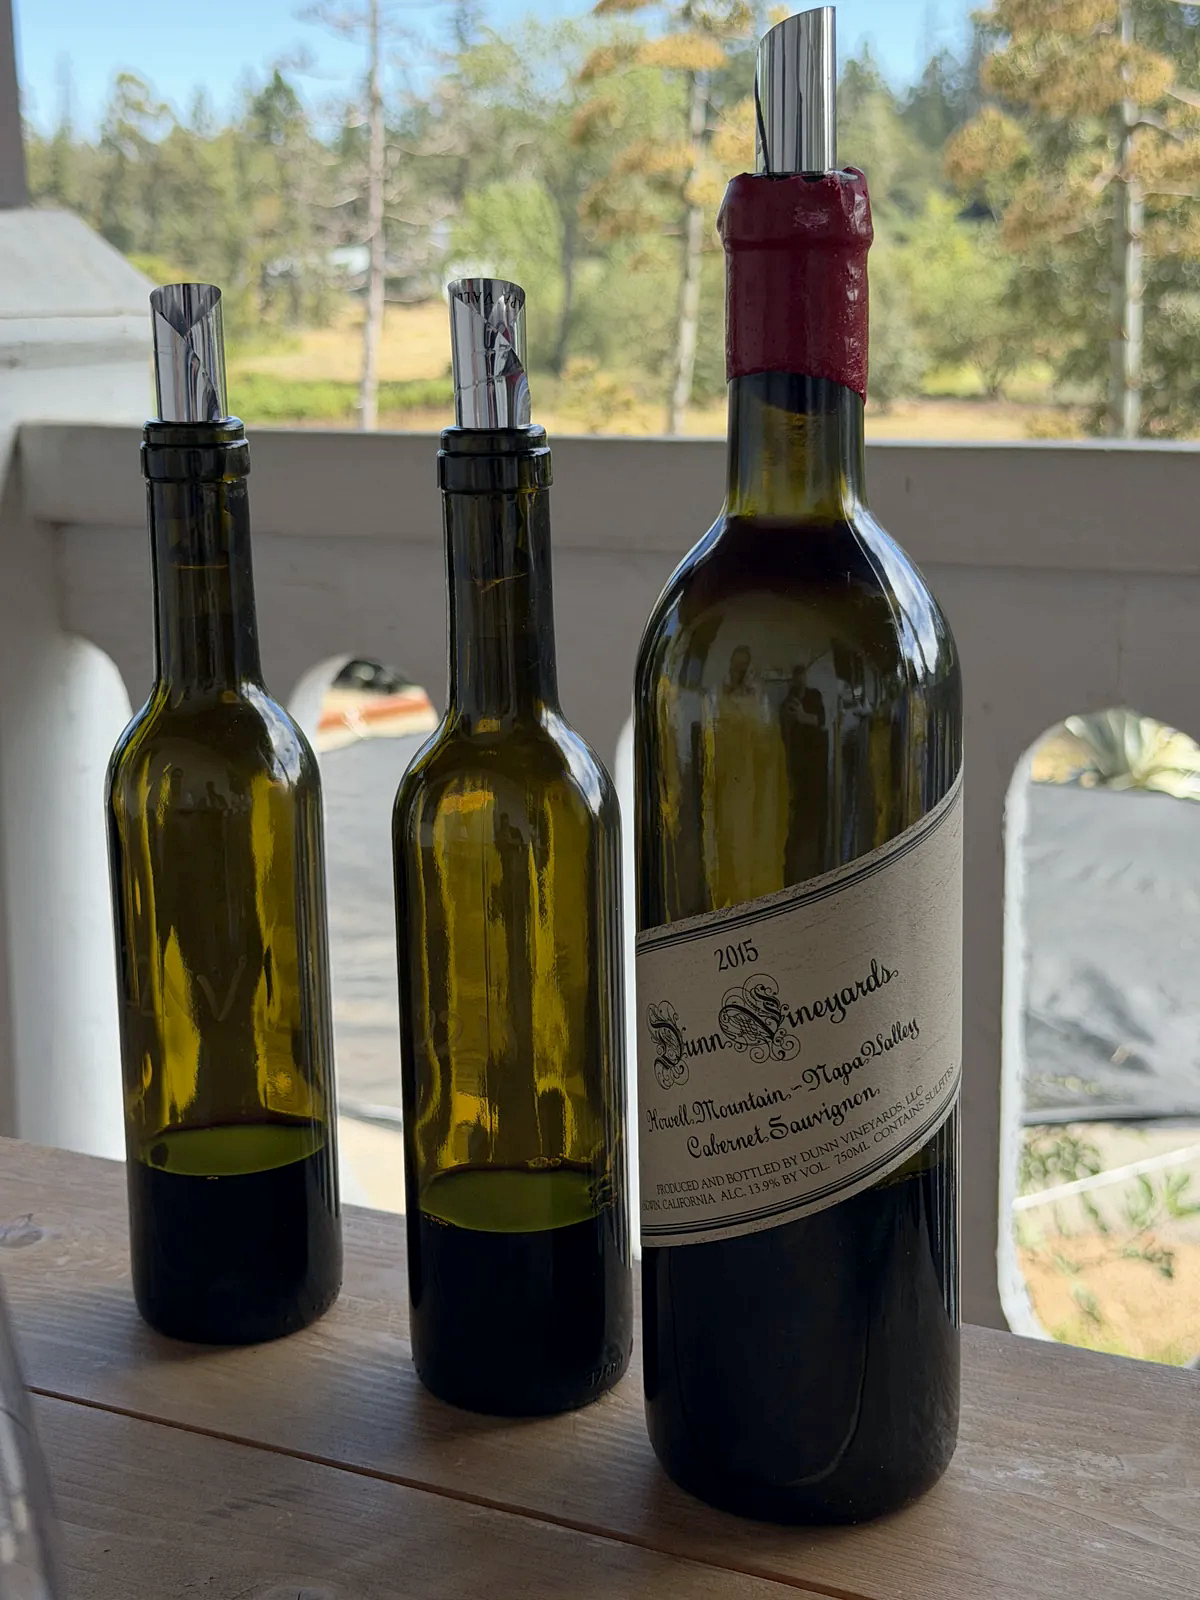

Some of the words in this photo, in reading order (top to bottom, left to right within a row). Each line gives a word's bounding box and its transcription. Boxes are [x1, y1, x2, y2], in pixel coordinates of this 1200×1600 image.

[714, 938, 758, 972] 2015
[646, 1000, 733, 1090] Dunn
[718, 958, 899, 1063] Vineyards
[646, 1104, 695, 1132] Howell
[692, 1088, 792, 1123] Mountain
[802, 1055, 870, 1092] Napa
[860, 1018, 920, 1058] Valley
[656, 1180, 700, 1196] PRODUCED
[701, 1175, 725, 1190] AND
[725, 1161, 781, 1184] BOTTLED
[782, 1155, 798, 1169] BY
[799, 1138, 839, 1162] DUNN
[840, 1101, 906, 1145] VINEYARDS,
[904, 1084, 924, 1105] LLC
[662, 1192, 717, 1210] CALIFORNIA
[721, 1187, 747, 1202] ALC.
[748, 1178, 781, 1195] 13.9%
[782, 1172, 798, 1186] BY
[799, 1162, 830, 1179] VOL.
[833, 1140, 871, 1165] 750ML
[873, 1101, 925, 1143] CONTAINS
[686, 1124, 769, 1159] Cabernet
[768, 1086, 881, 1140] Sauvignon
